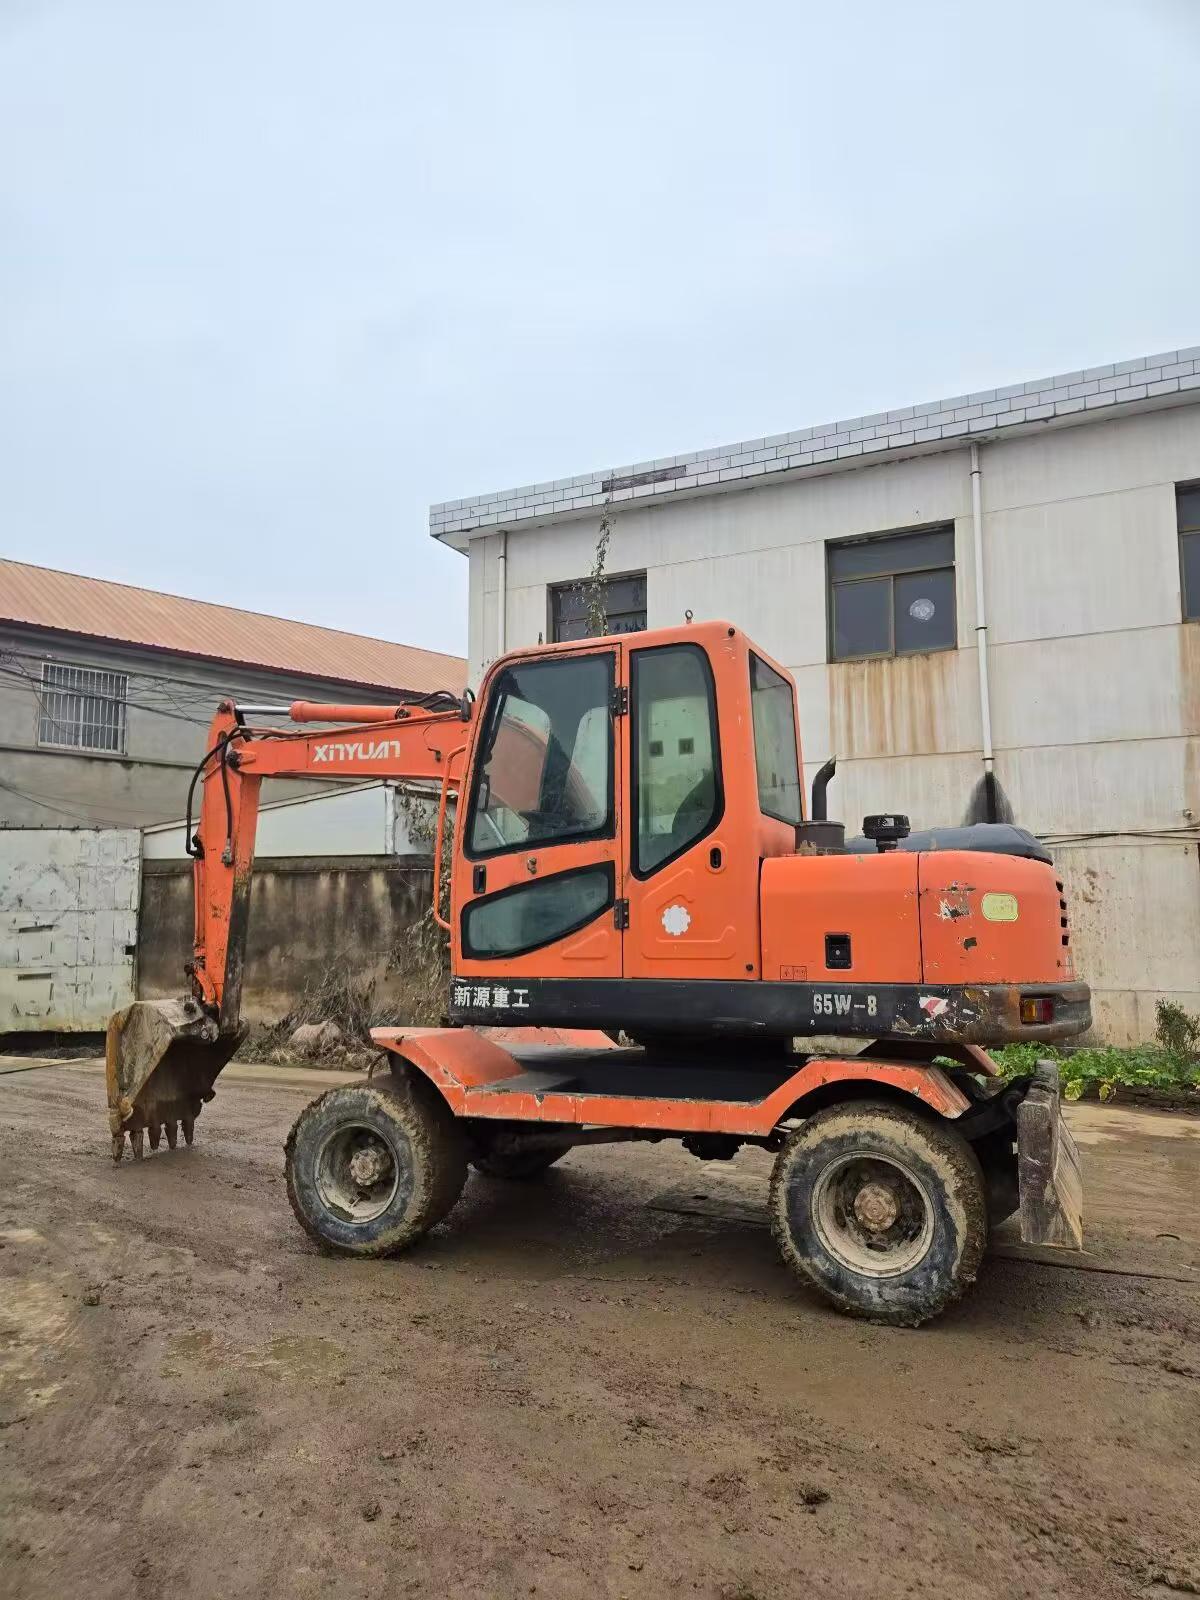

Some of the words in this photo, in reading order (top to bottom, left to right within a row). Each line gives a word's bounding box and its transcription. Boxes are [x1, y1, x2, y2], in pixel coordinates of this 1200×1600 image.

[454, 985, 530, 1008] 新源重工
[813, 993, 877, 1017] 65W-8
